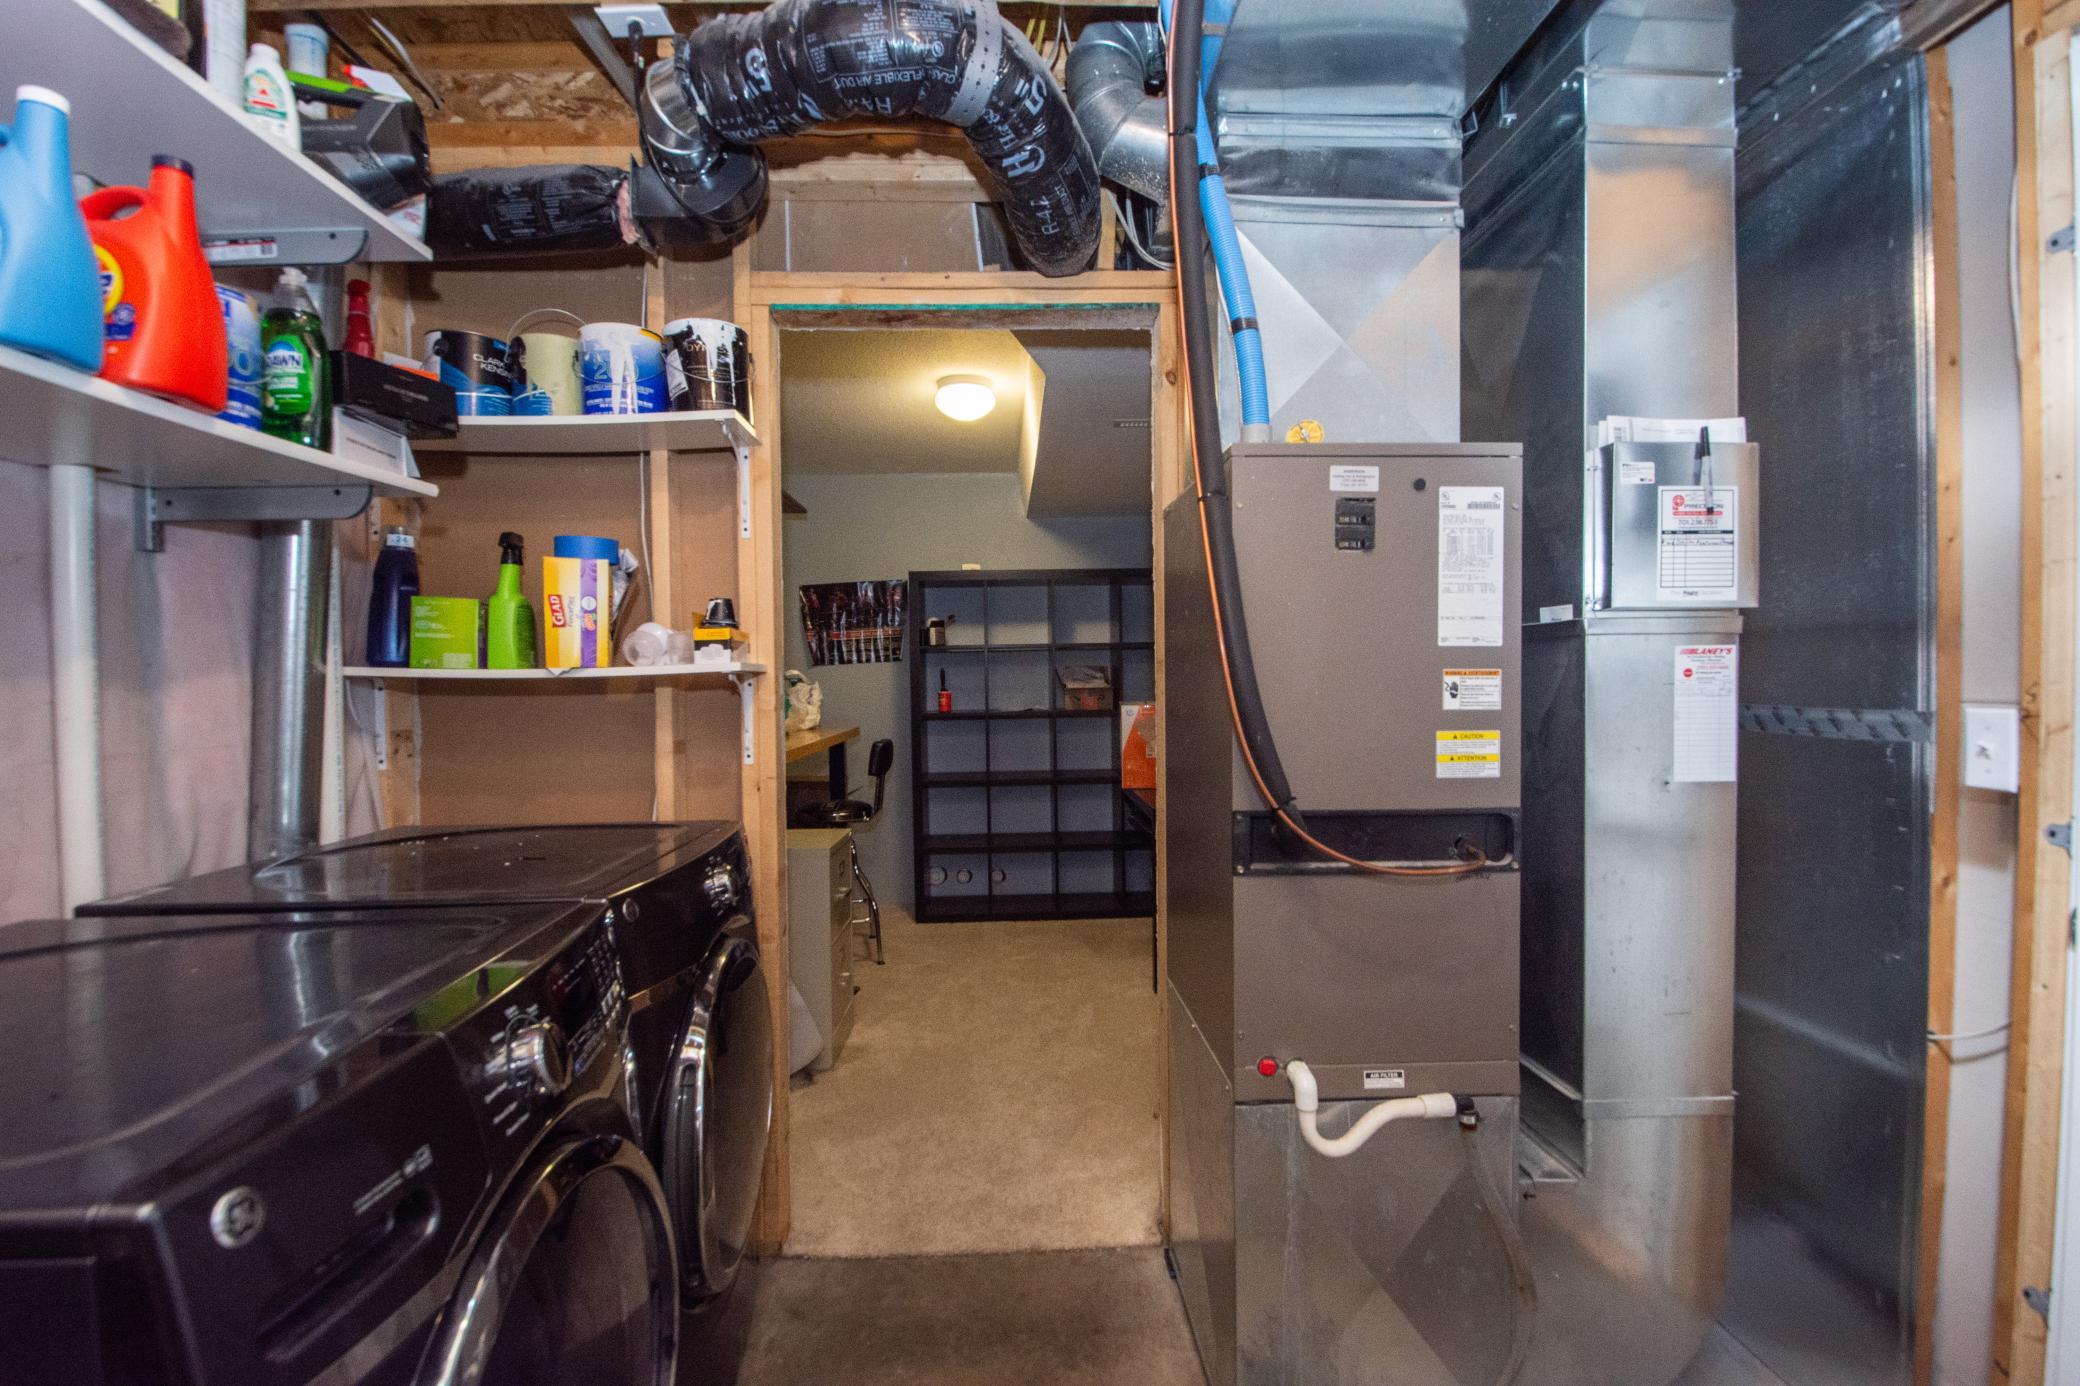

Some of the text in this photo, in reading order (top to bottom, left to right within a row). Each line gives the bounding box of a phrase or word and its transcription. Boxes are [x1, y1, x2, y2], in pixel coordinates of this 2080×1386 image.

[873, 67, 925, 85] FLEXIBLE
[266, 352, 302, 368] DAWN
[472, 352, 506, 368] CLARK
[549, 594, 567, 626] GLAD
